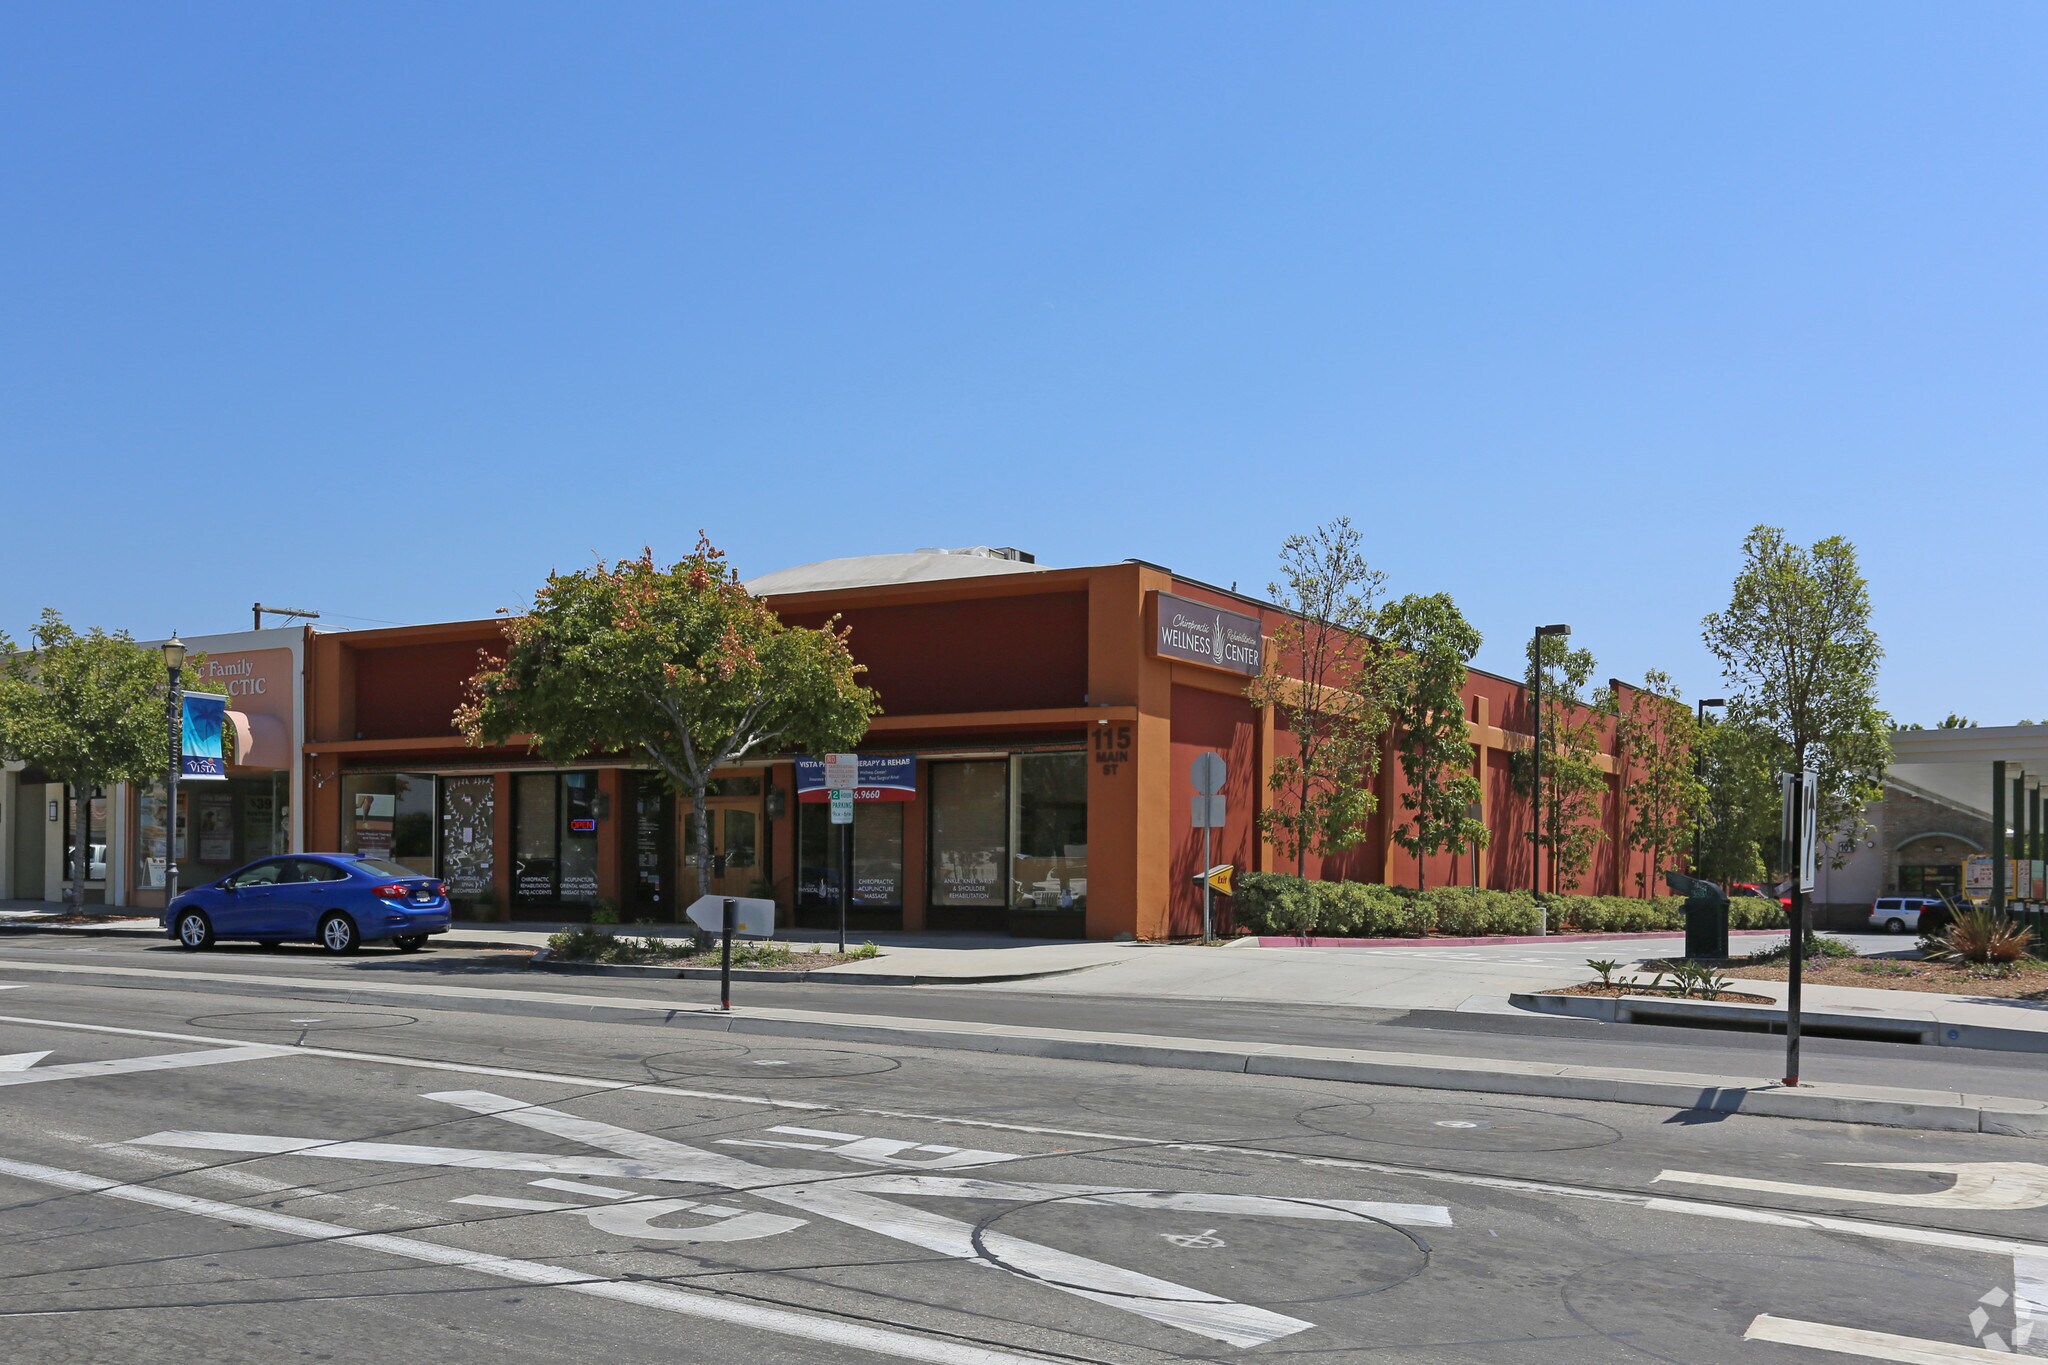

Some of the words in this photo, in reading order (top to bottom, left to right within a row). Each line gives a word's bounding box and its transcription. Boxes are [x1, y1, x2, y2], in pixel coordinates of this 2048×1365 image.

[1172, 613, 1210, 634] Chiropractic
[1161, 626, 1211, 655] WELLNESS
[1225, 643, 1259, 666] CENTER
[209, 659, 253, 676] Family
[1091, 726, 1131, 750] 115
[887, 758, 911, 766] REHAB
[1095, 751, 1128, 763] MAIN
[189, 763, 217, 774] VISTA
[1103, 763, 1119, 775] ST
[833, 790, 840, 799] 2
[832, 801, 852, 809] PARKING
[571, 821, 593, 829] OPEN
[1217, 875, 1228, 884] Exit
